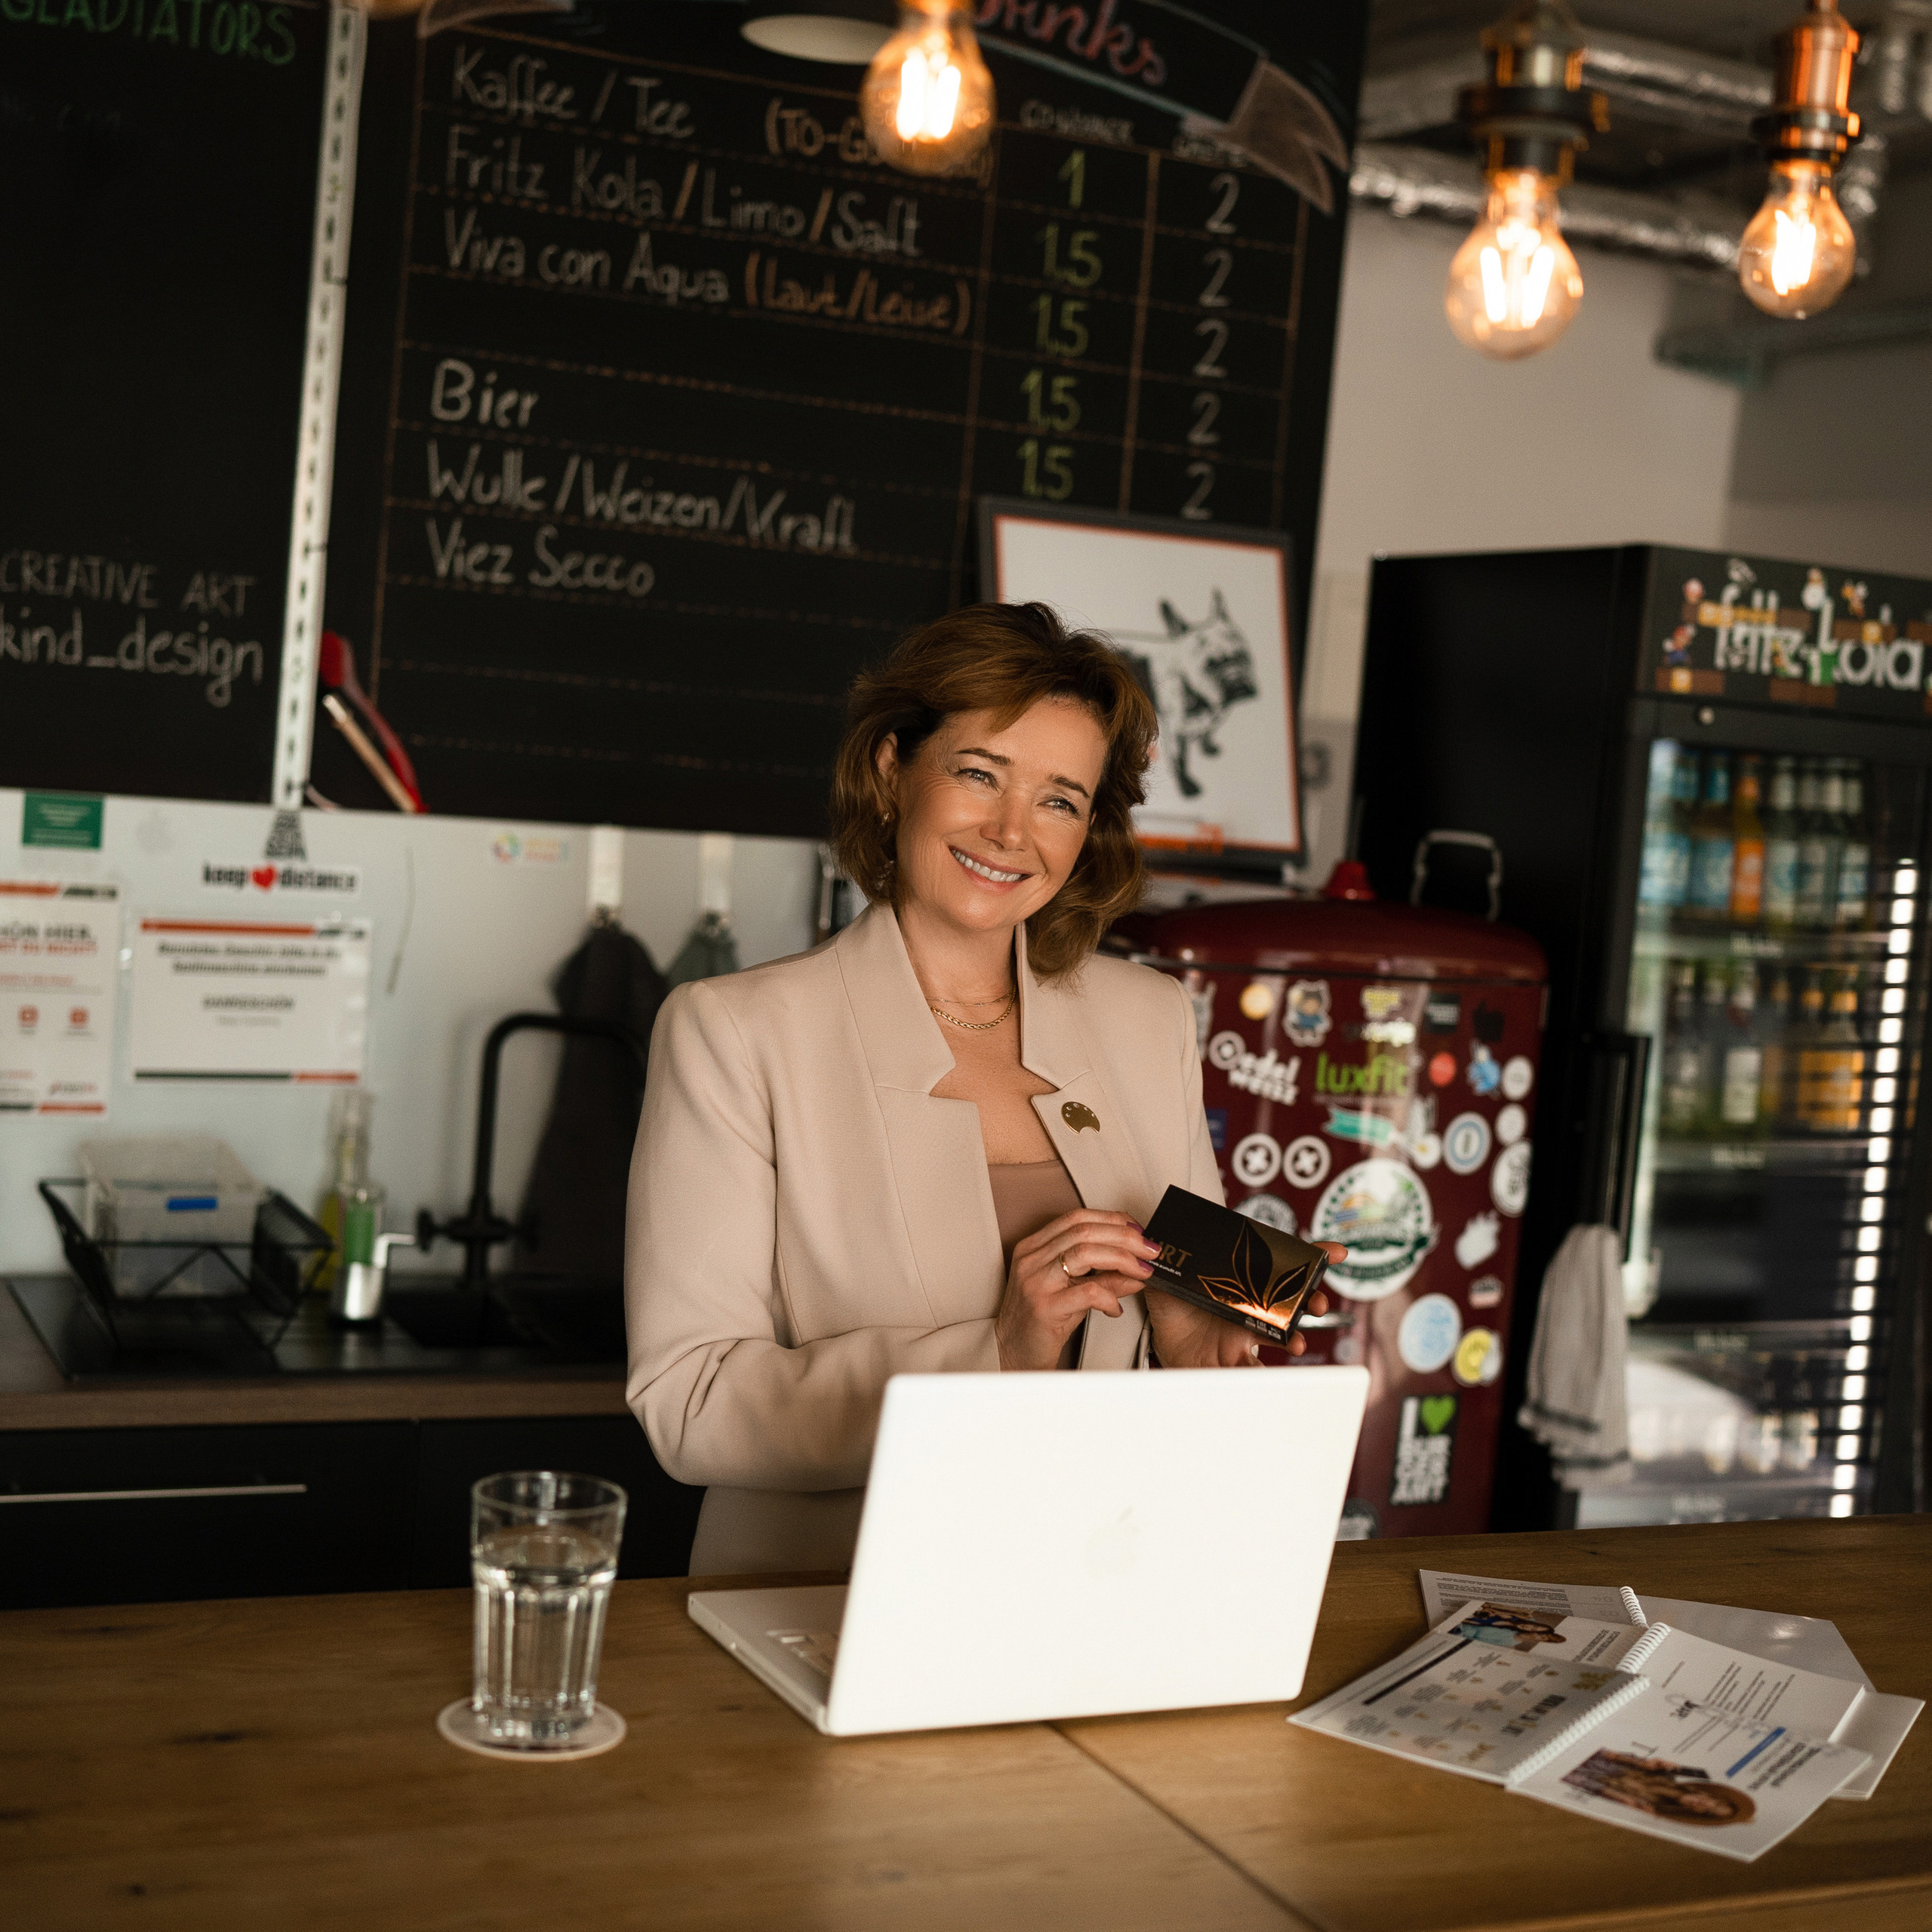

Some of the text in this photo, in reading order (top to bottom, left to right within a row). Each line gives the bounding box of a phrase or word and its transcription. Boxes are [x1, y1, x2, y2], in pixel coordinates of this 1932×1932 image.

[453, 43, 579, 118] Kaffee
[627, 78, 696, 138] Tee
[446, 125, 546, 198] Fritz
[1057, 150, 1086, 208] 1
[1207, 172, 1240, 233] 2
[445, 207, 526, 278] Viva
[538, 242, 610, 288] con
[623, 230, 729, 303] Aqua
[1199, 249, 1234, 306] 2
[1193, 319, 1229, 377] 2
[429, 357, 539, 429] Bier
[1187, 392, 1222, 445] 2
[1180, 462, 1217, 519] 2
[425, 516, 655, 598] Viez Secco
[181, 571, 257, 616] ART
[202, 860, 248, 890] keep
[1315, 1051, 1409, 1096] luxfit
[1150, 1238, 1192, 1268] RT
